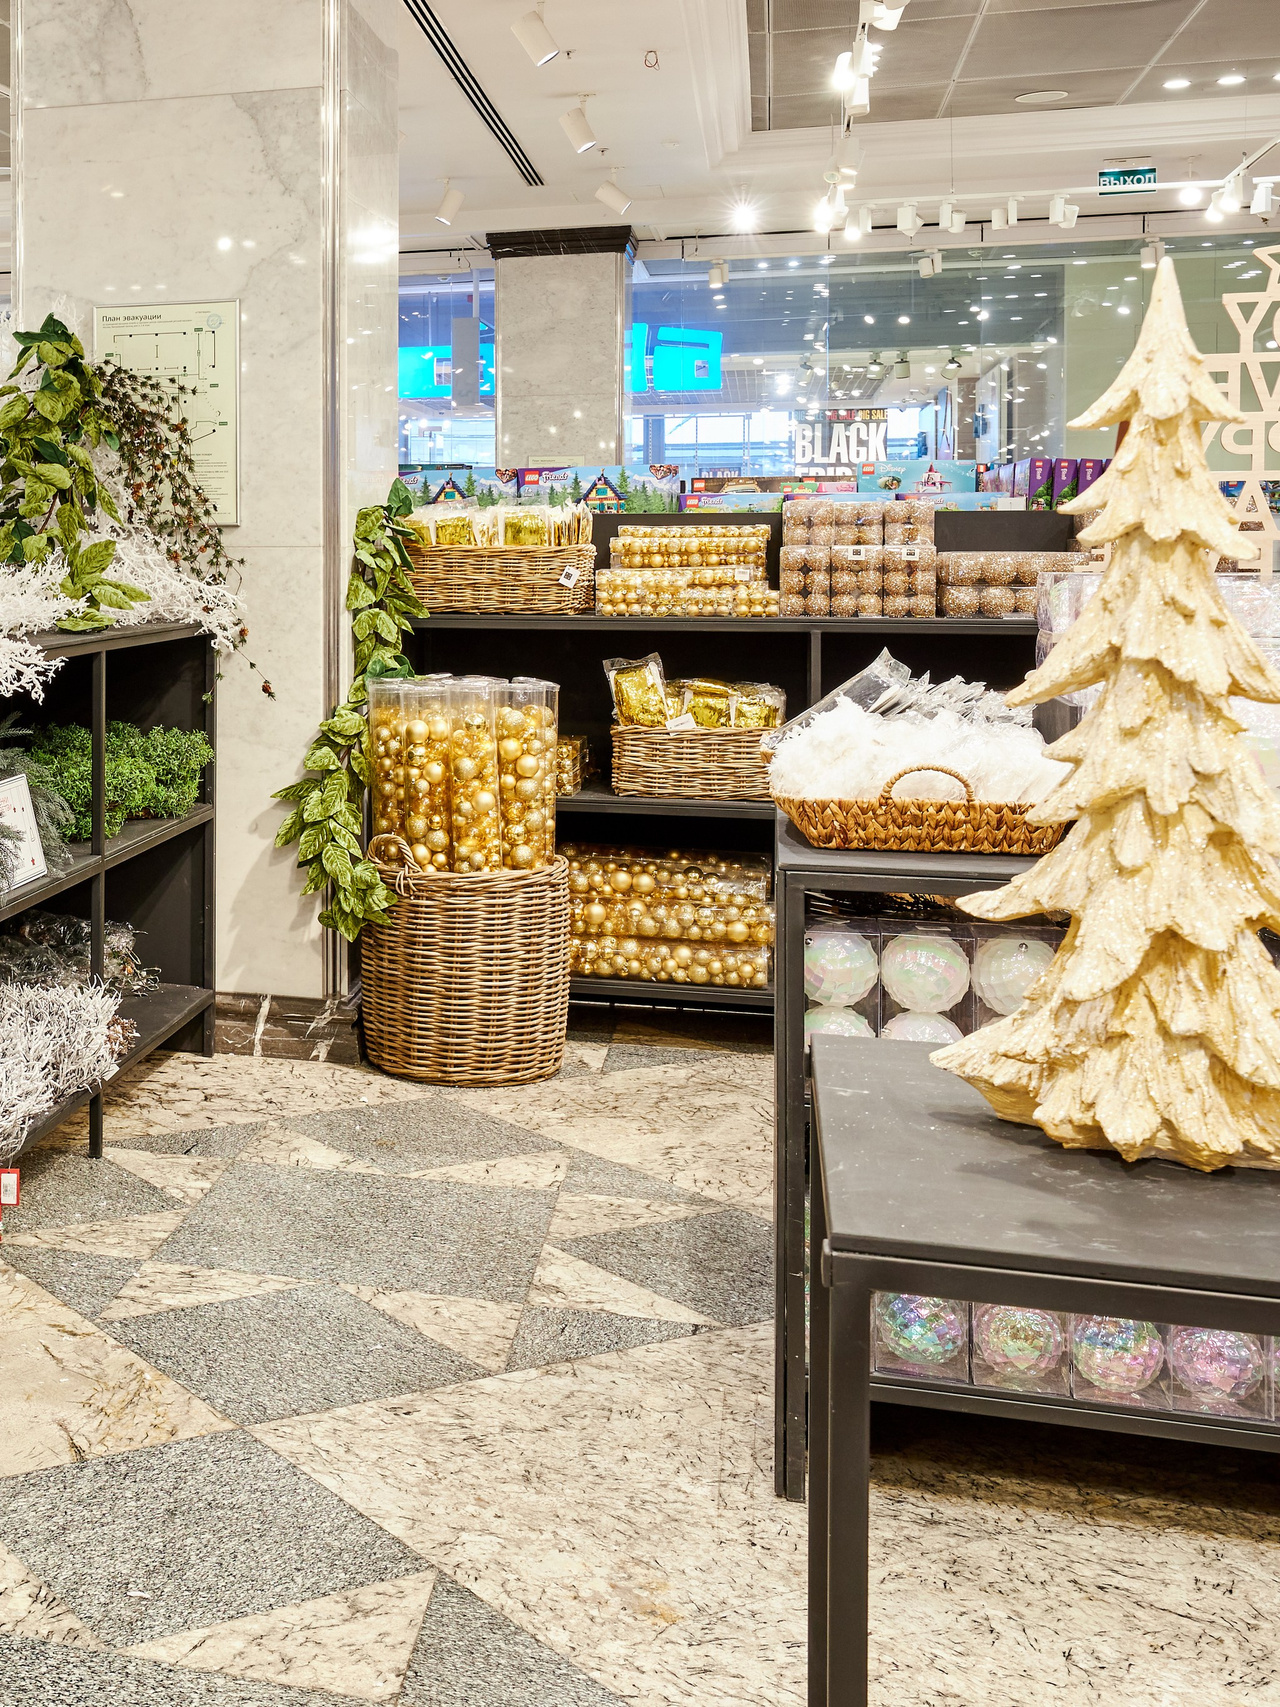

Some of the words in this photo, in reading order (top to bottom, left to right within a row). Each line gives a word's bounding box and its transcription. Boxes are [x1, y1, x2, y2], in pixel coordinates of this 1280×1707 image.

[871, 409, 888, 419] SALE
[795, 422, 888, 463] BLACK
[878, 463, 906, 474] Disney
[542, 471, 568, 483] Friends
[701, 497, 723, 507] Friends
